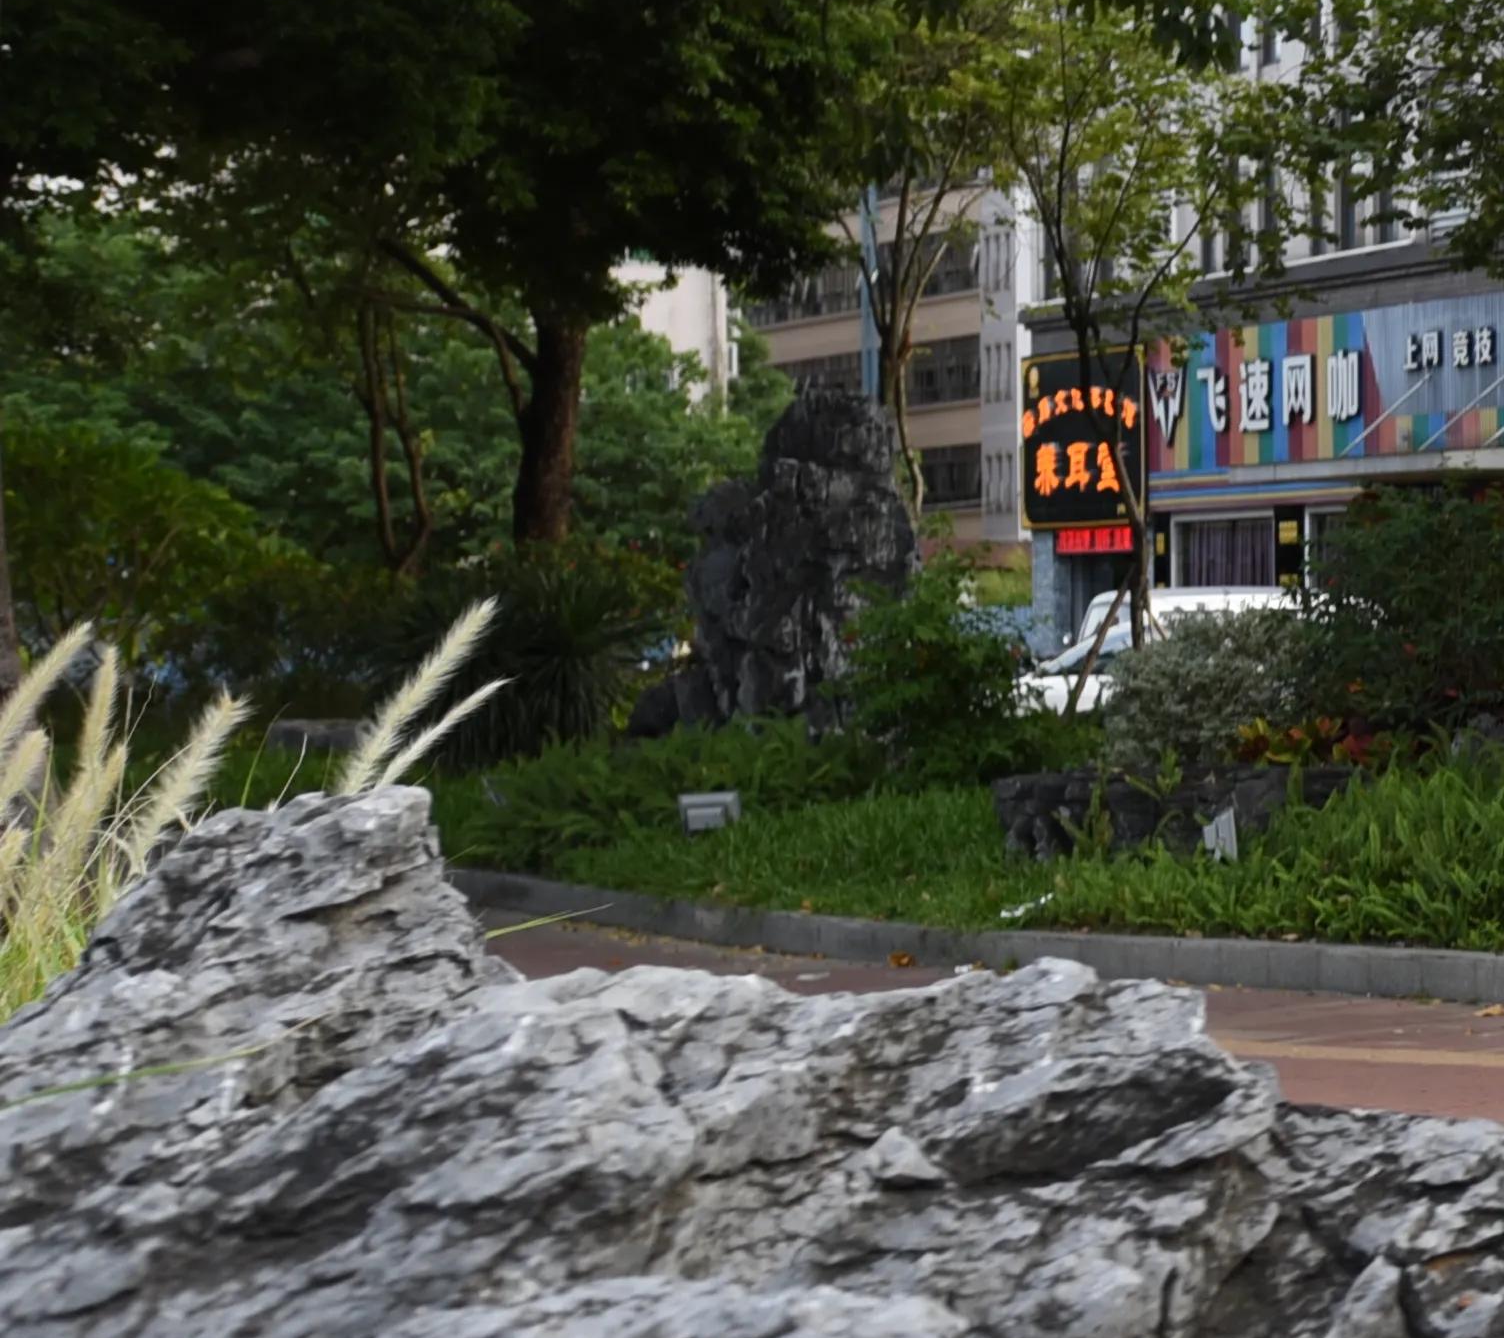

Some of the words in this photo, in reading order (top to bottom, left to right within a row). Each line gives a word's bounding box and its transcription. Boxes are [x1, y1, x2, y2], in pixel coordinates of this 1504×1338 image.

[1402, 330, 1440, 371] 上网
[1451, 325, 1493, 369] 竞技
[1196, 348, 1359, 433] 飞速网咖
